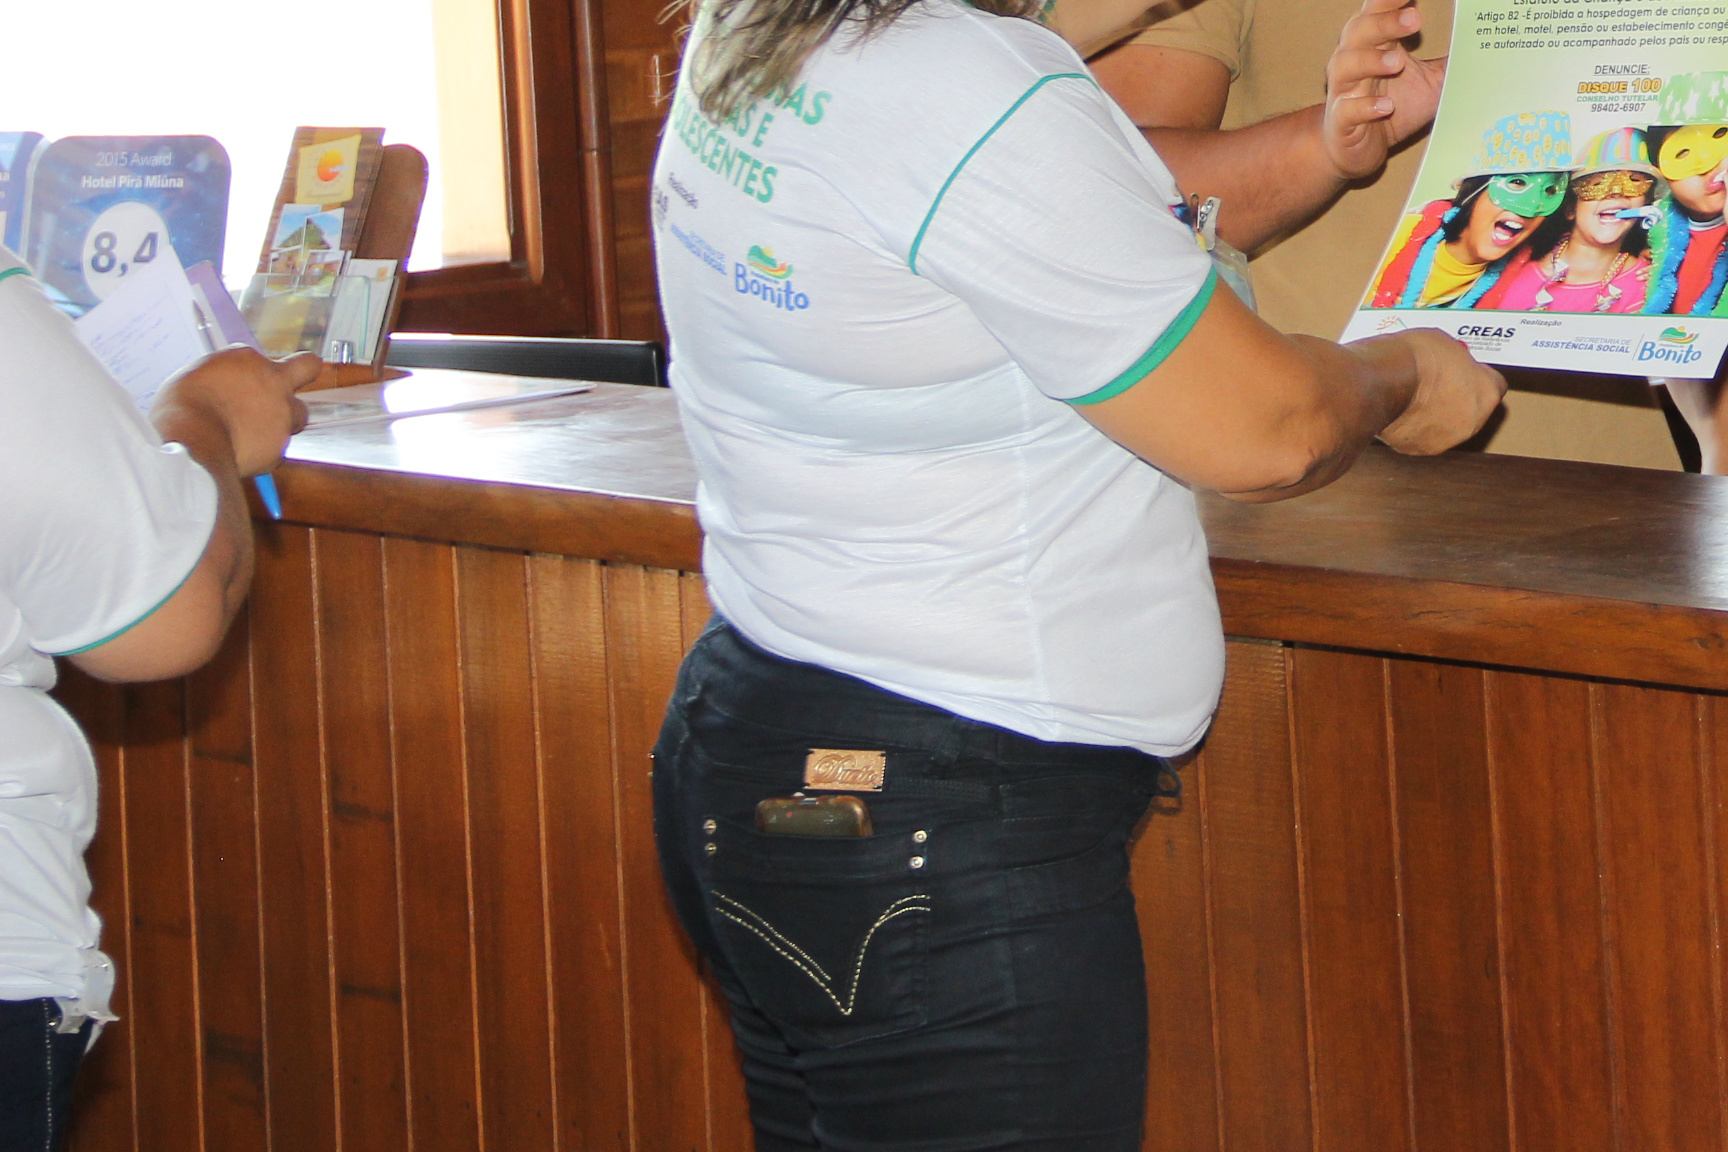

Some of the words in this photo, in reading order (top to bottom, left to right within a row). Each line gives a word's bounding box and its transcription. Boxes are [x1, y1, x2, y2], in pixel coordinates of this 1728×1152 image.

[1507, 11, 1519, 20] 82
[1533, 10, 1574, 21] proibida
[1586, 7, 1652, 21] hospedagem
[1655, 8, 1669, 16] de
[1672, 6, 1710, 18] criança
[1713, 7, 1726, 15] ou
[1476, 27, 1492, 35] em
[1494, 25, 1521, 36] hotel,
[1524, 24, 1554, 34] motel,
[1556, 23, 1594, 35] pensão
[1611, 20, 1695, 32] estabelecimento
[1480, 41, 1491, 49] se
[1493, 38, 1545, 49] autorizado
[1547, 39, 1560, 48] ou
[1563, 37, 1637, 49] acompanhado
[1639, 35, 1666, 47] pelos
[1669, 34, 1690, 46] pais
[1692, 36, 1705, 44] ou
[1594, 64, 1651, 76] DENUNCIE:
[1577, 81, 1628, 94] DISQUE
[1631, 77, 1662, 93] 100
[1591, 103, 1646, 112] 98402-6907
[752, 112, 774, 147] E
[96, 152, 127, 166] 2015
[130, 151, 172, 166] Award
[82, 175, 116, 189] Hotel
[119, 174, 143, 189] Pirá
[146, 174, 184, 189] Miúna
[735, 262, 809, 311] Bonito
[1520, 318, 1562, 327] Realização
[1457, 325, 1516, 338] CREAS
[1531, 339, 1593, 351] ASSISTÊNCIA
[1596, 344, 1630, 353] SOCIAL
[1575, 336, 1619, 344] SECRETARIA
[1638, 341, 1702, 364] Bonito
